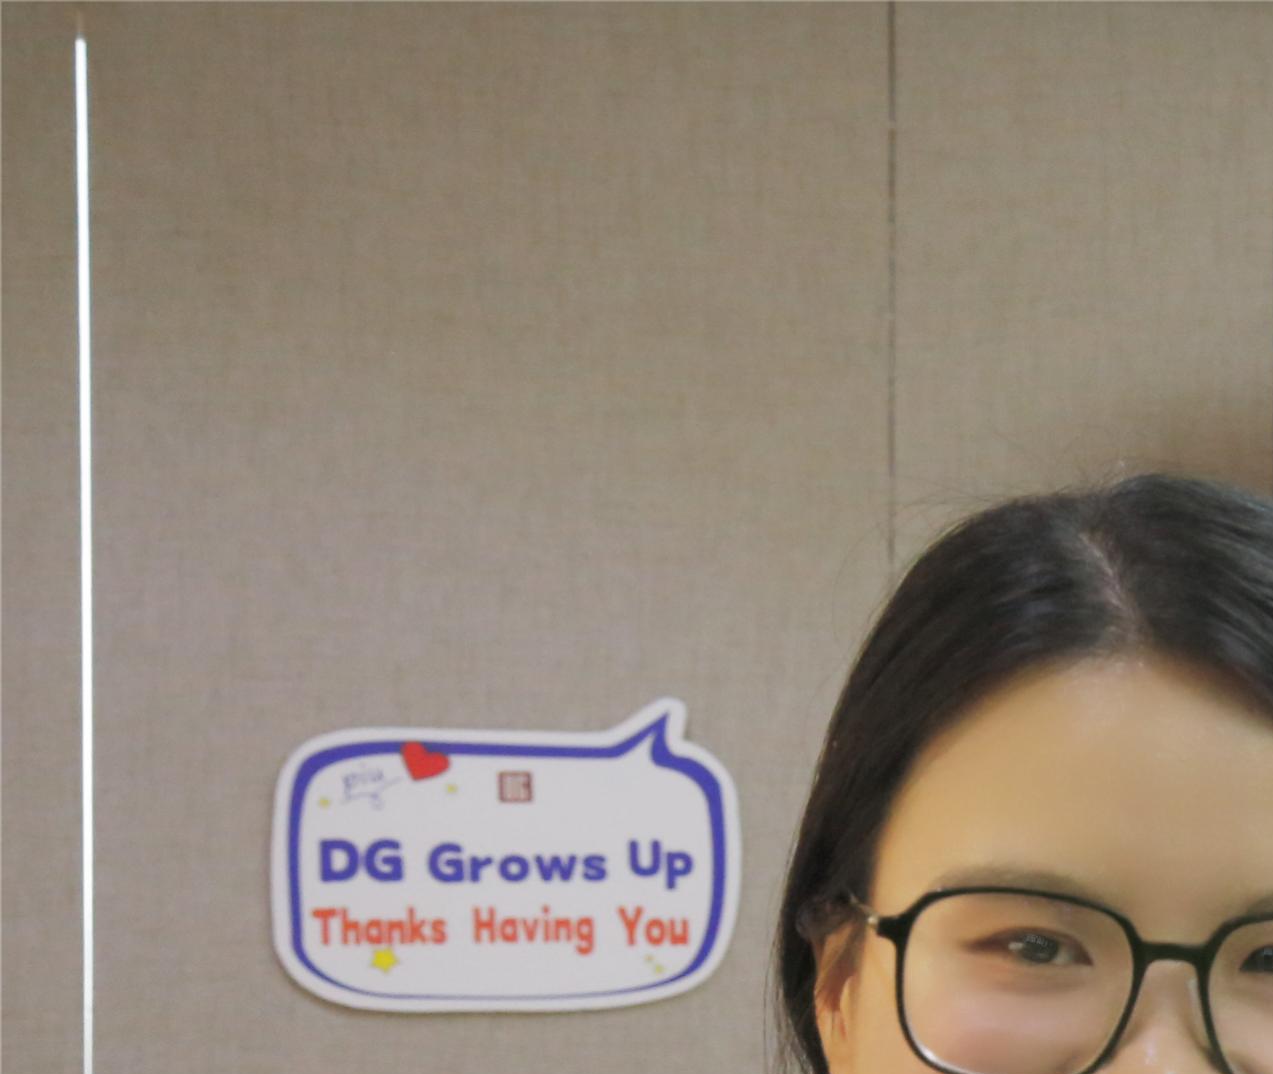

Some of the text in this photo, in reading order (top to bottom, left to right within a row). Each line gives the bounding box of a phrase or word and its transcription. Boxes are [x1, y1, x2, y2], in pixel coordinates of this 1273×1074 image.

[318, 838, 695, 891] DG Grows Up
[311, 905, 691, 956] Thanks Having You
